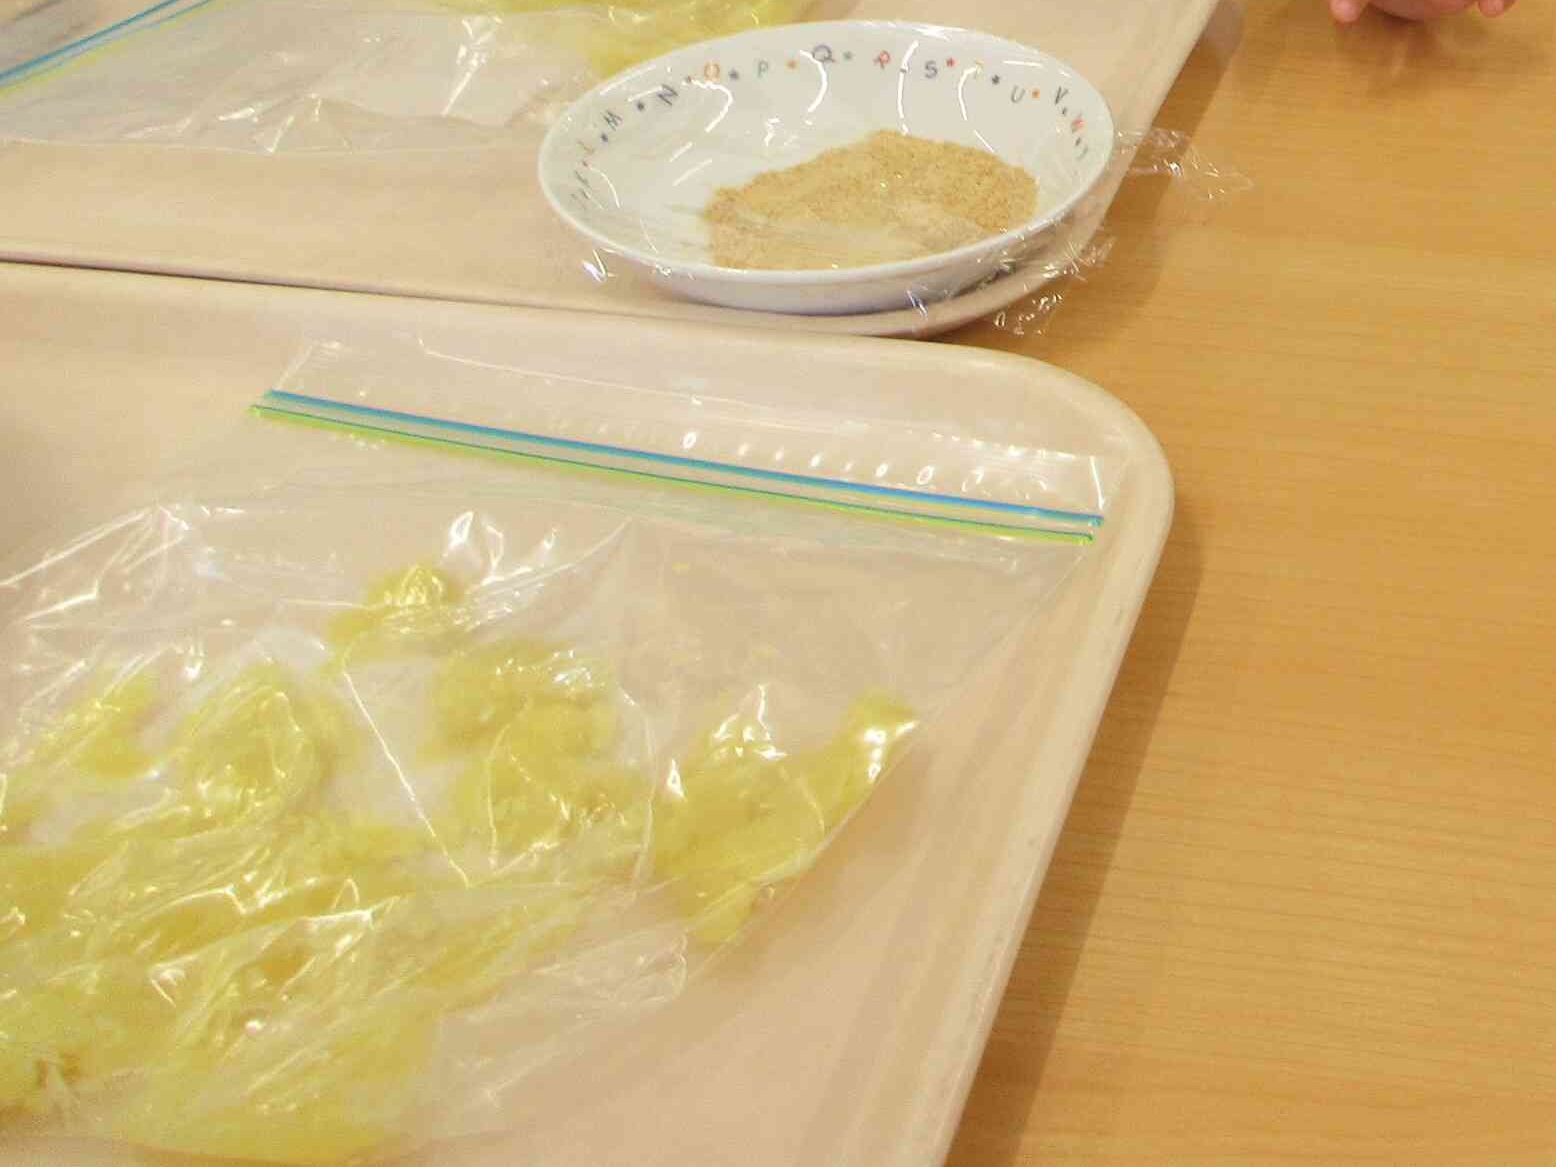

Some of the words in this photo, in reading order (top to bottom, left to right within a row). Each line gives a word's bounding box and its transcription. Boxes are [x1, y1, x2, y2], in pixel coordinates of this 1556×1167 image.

[655, 83, 680, 107] N
[756, 59, 770, 78] P
[811, 43, 836, 64] Q
[873, 49, 891, 70] R
[923, 59, 939, 80] S
[1010, 85, 1027, 104] U
[1054, 85, 1070, 106] V
